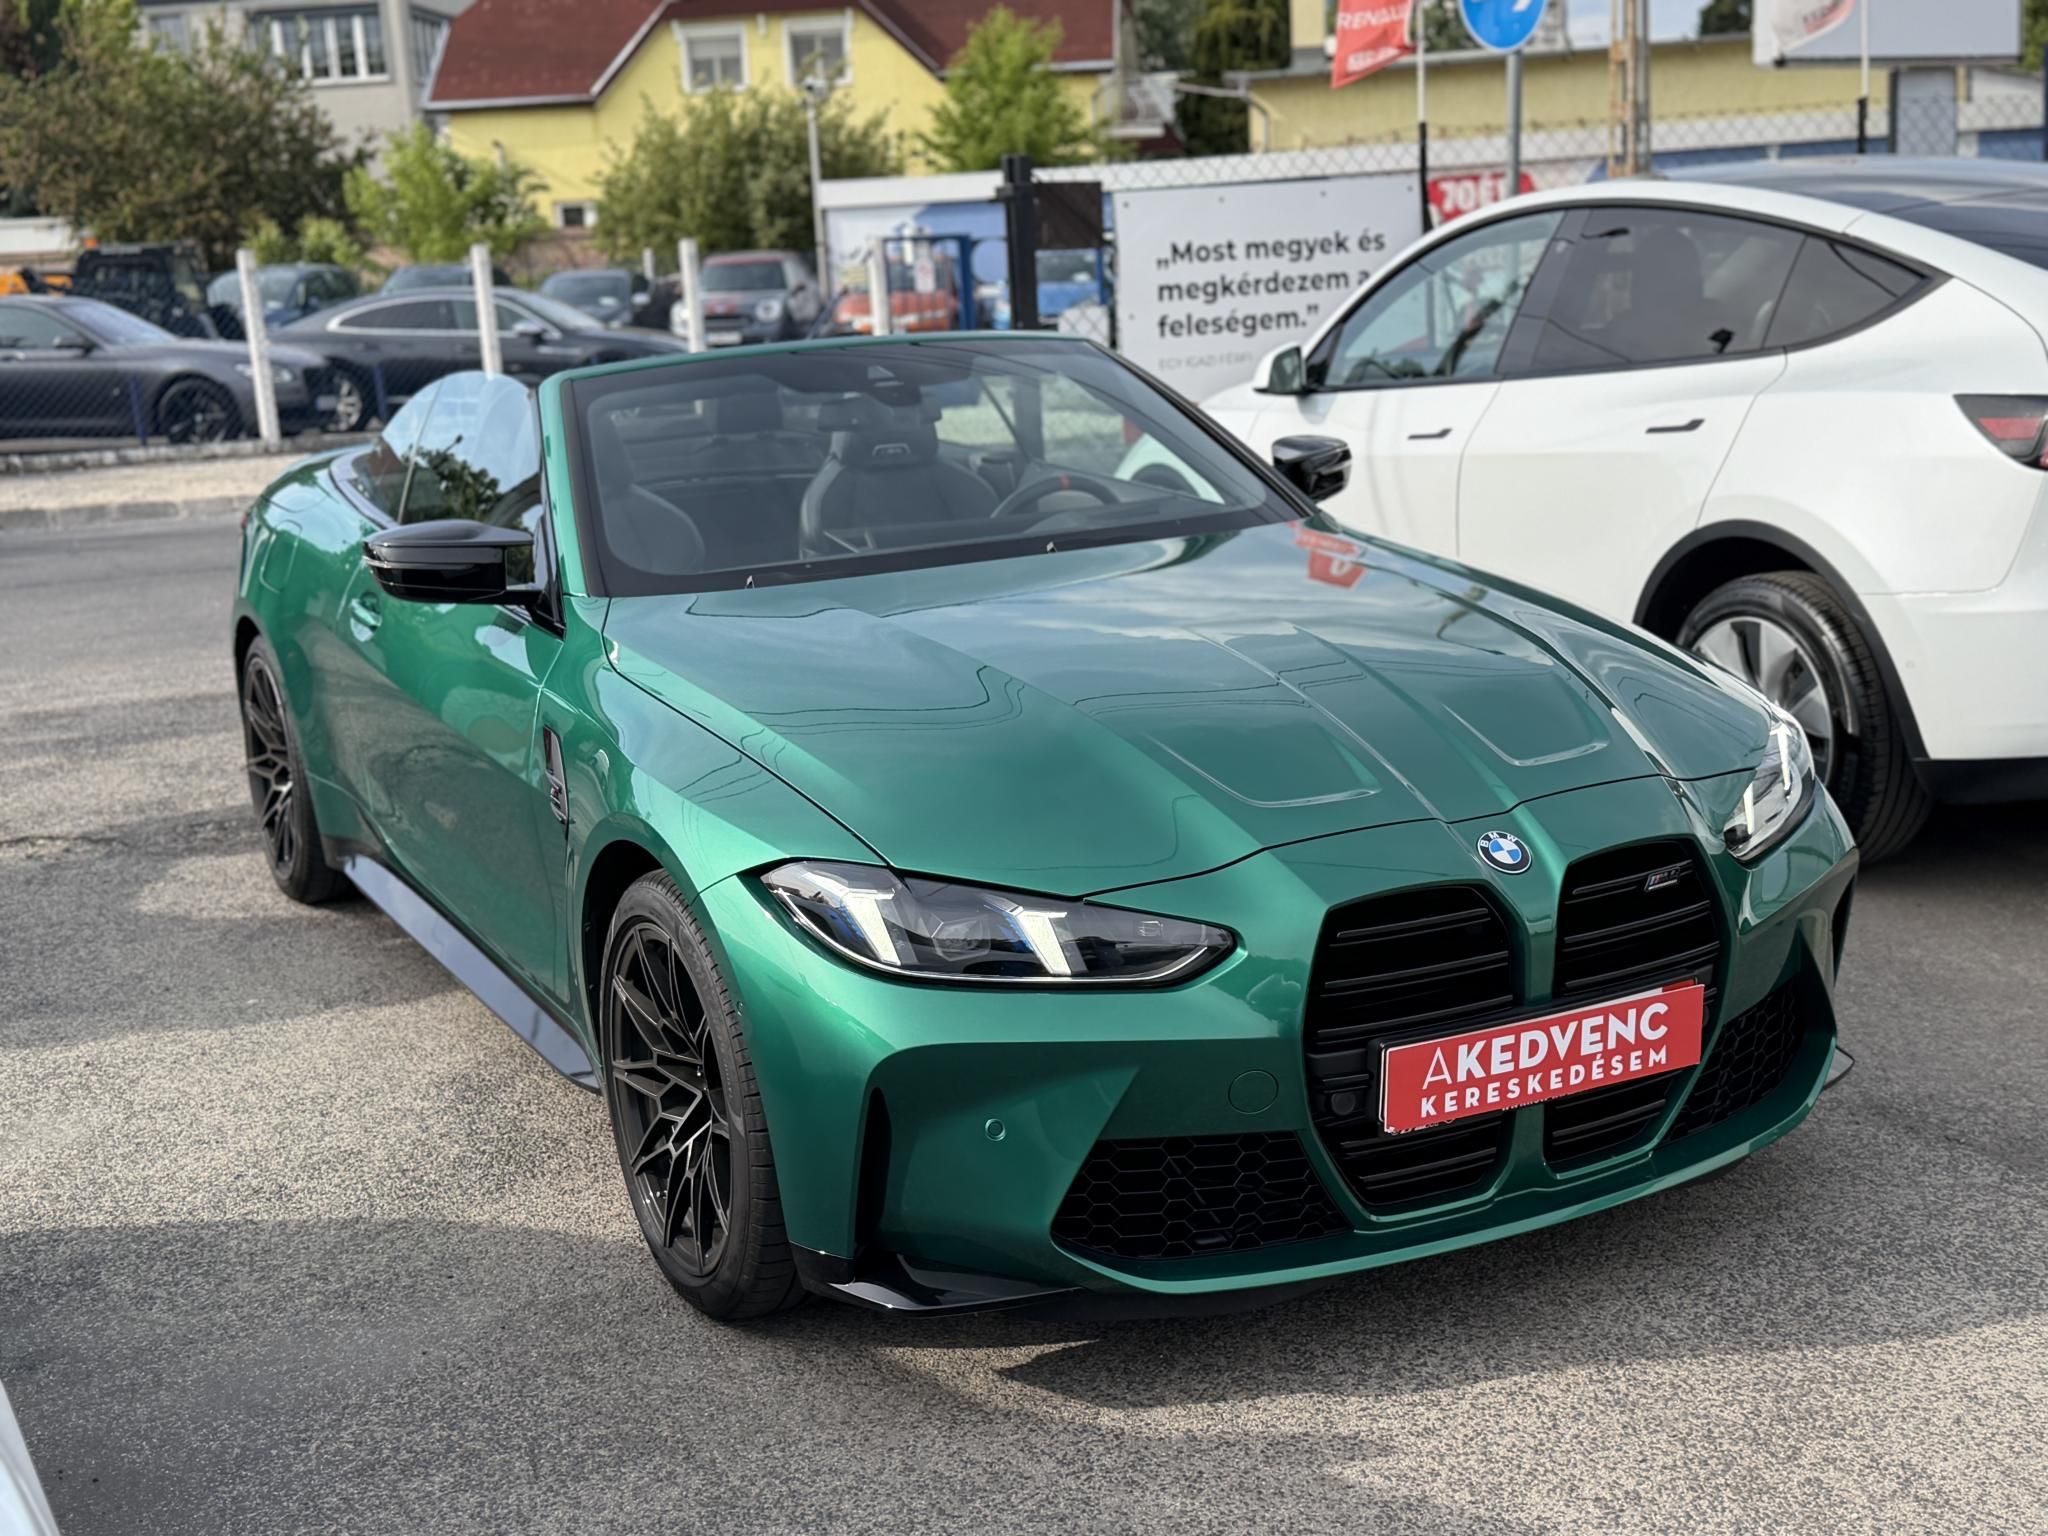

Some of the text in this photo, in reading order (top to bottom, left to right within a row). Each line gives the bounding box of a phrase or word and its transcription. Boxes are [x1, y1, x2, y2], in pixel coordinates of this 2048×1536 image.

[1245, 231, 1349, 262] megyek
[1357, 228, 1386, 251] és
[1157, 270, 1349, 305] megkérdezem
[1480, 832, 1518, 848] BMW
[1420, 1045, 1667, 1118] KERESKEDÉSEM
